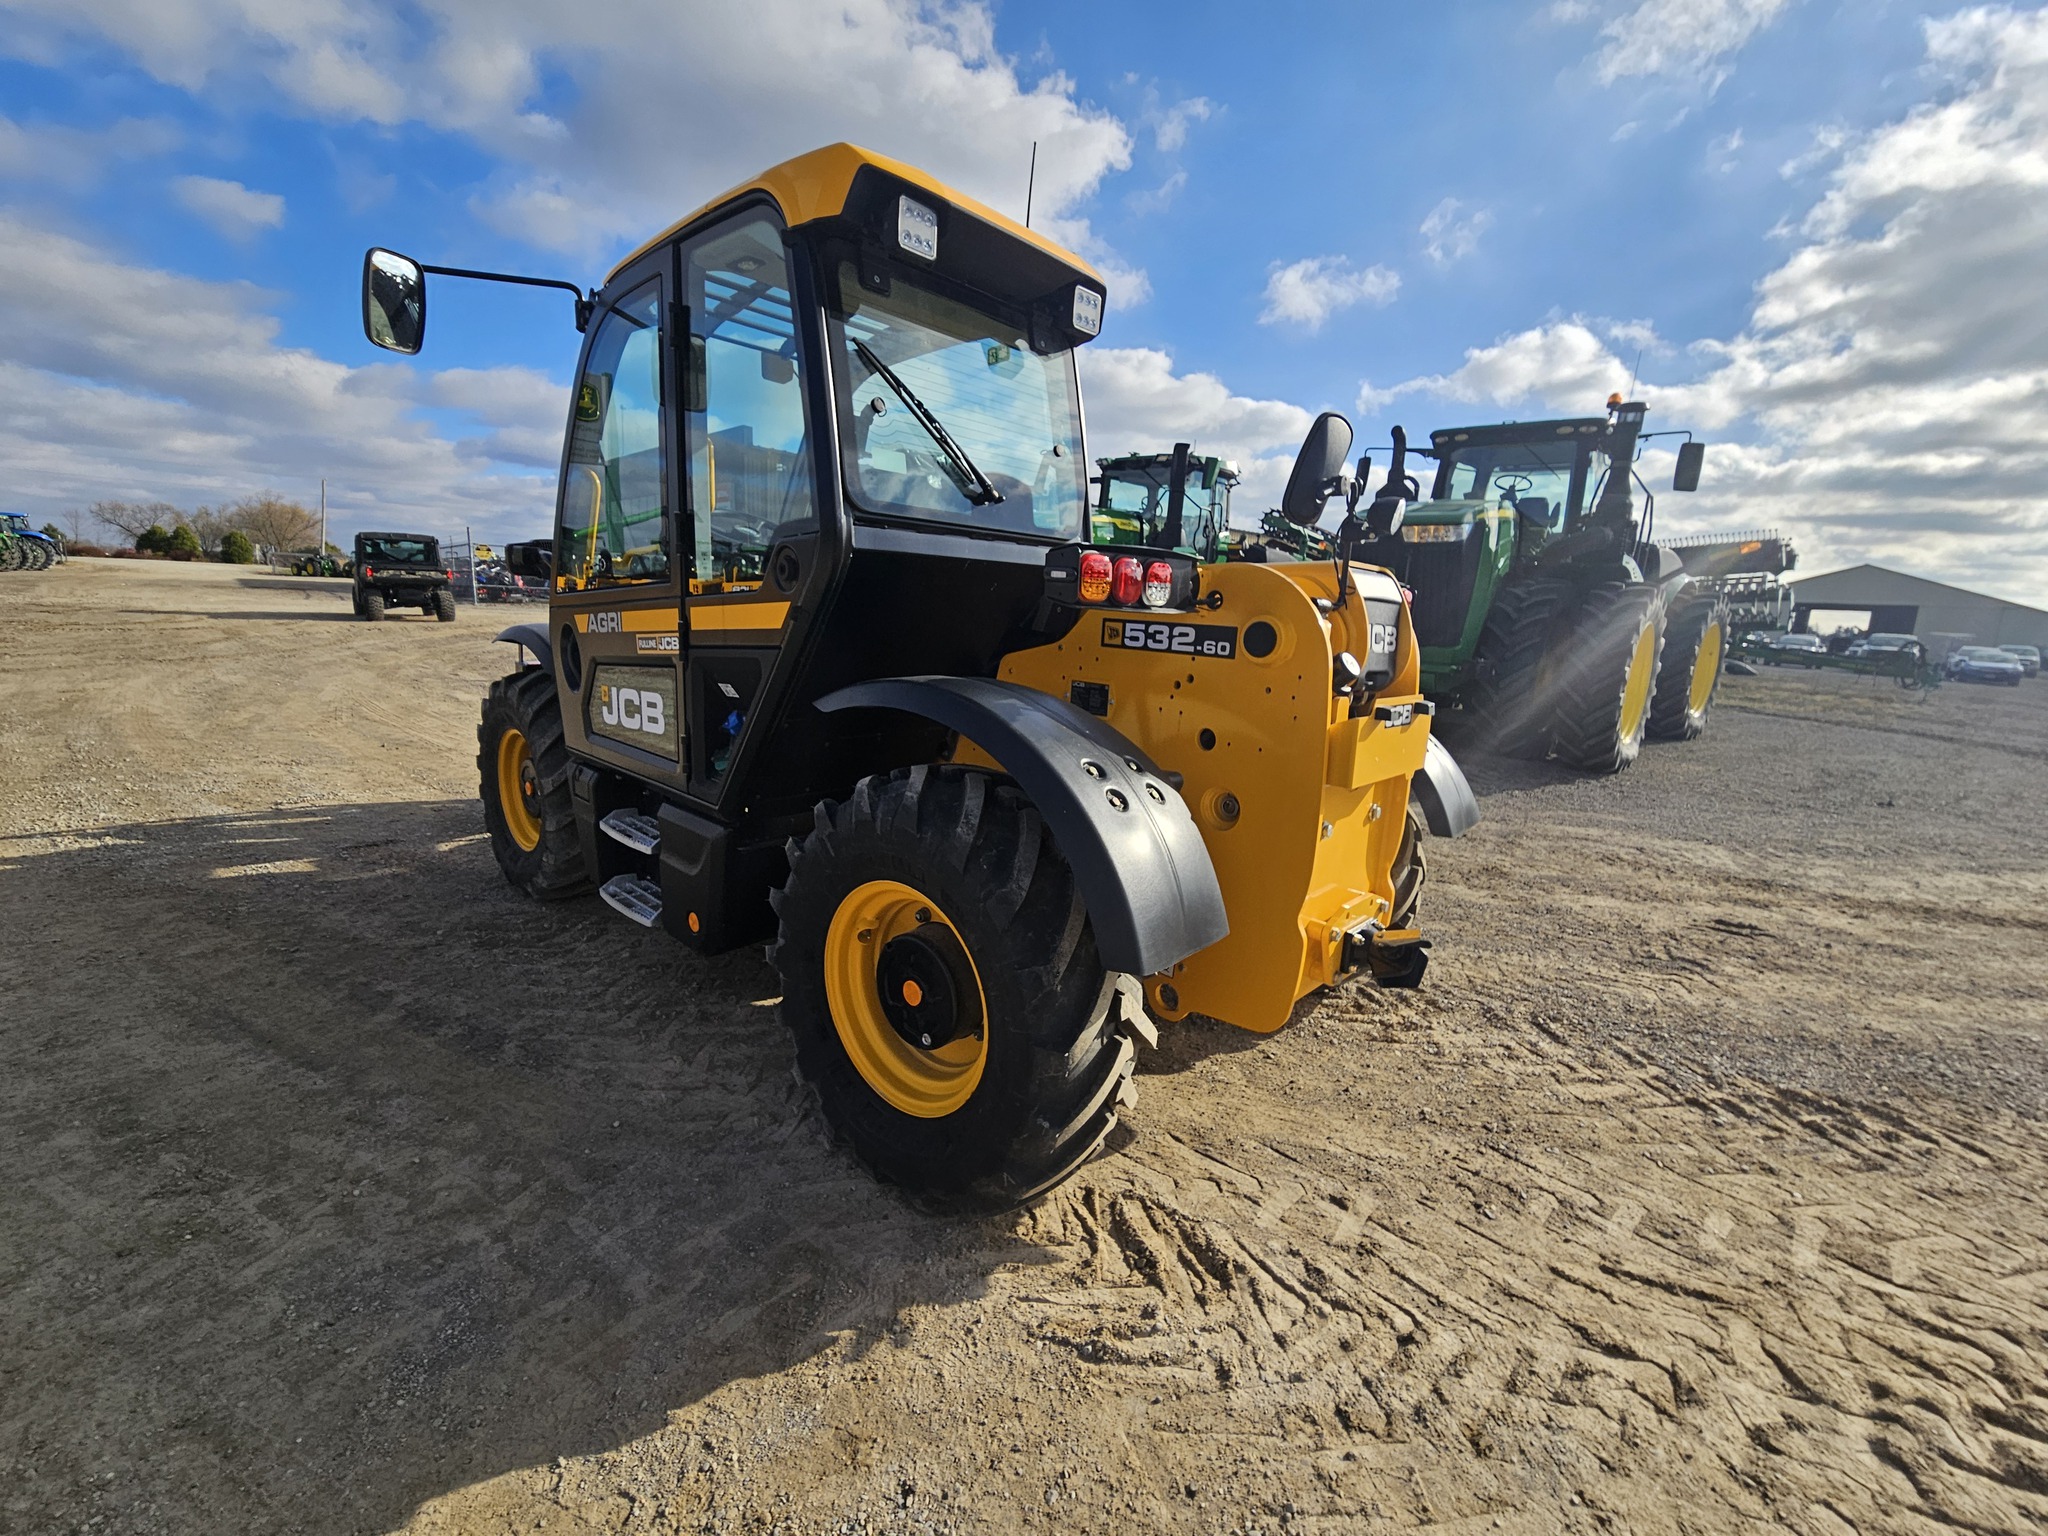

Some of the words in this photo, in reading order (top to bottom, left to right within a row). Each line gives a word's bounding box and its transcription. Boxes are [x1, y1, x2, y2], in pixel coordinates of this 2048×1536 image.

[588, 611, 622, 633] AGRI
[658, 636, 680, 650] JCB
[1123, 622, 1231, 656] 532-60
[602, 686, 666, 735] JCB
